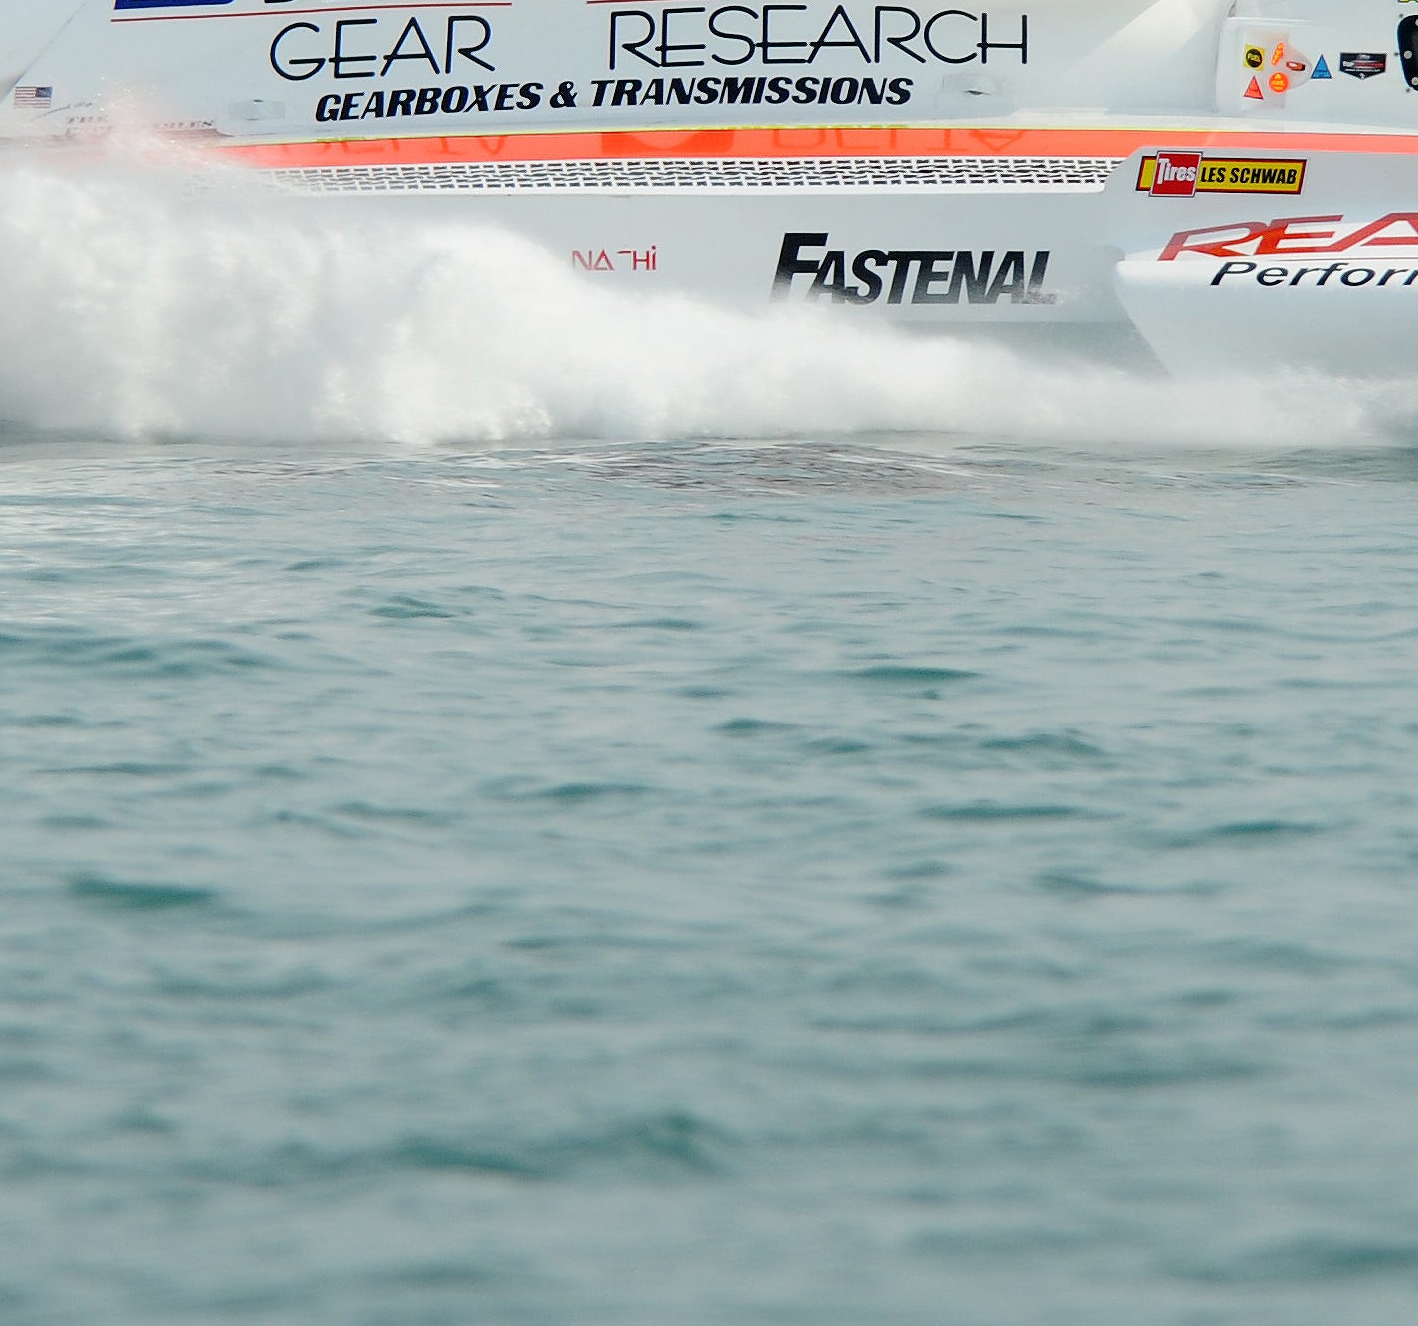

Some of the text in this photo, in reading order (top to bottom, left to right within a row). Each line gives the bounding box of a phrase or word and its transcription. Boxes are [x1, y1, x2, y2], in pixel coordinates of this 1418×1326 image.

[270, 15, 496, 81] GEAR
[609, 4, 1028, 70] RESEARCH
[315, 76, 914, 122] GEARBOXES & TRANSMISSIONS
[1157, 158, 1298, 184] Tires LES SCHWAB
[572, 245, 657, 270] NAHi
